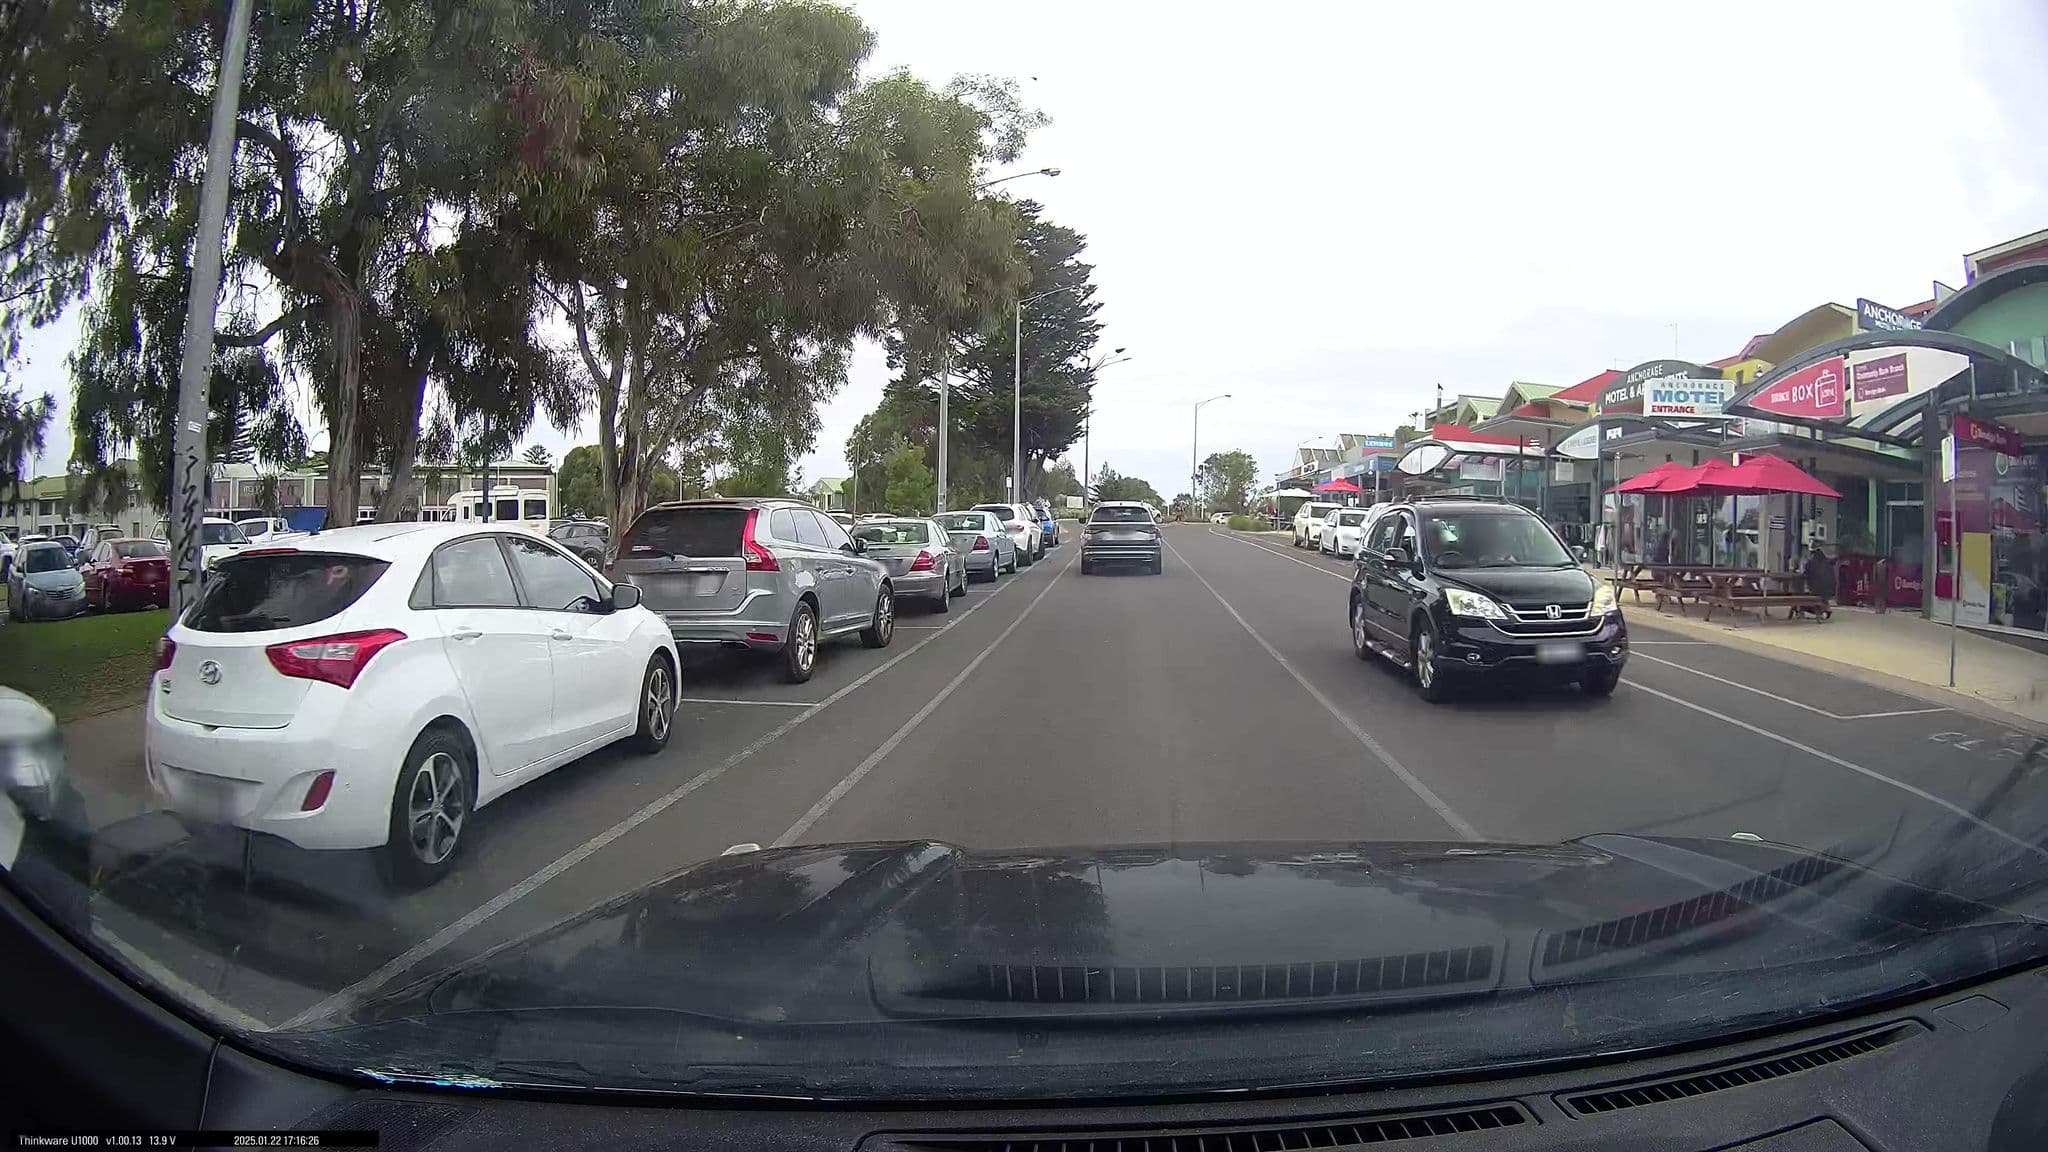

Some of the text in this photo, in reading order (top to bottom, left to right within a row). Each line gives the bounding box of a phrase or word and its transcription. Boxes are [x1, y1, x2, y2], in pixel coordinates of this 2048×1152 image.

[1864, 303, 1922, 330] ANCHOGE
[1627, 365, 1663, 383] ANCHORAGE
[1605, 388, 1628, 405] MOTEL
[1792, 383, 1814, 403] BOX
[1652, 405, 1695, 414] ENTRANCE
